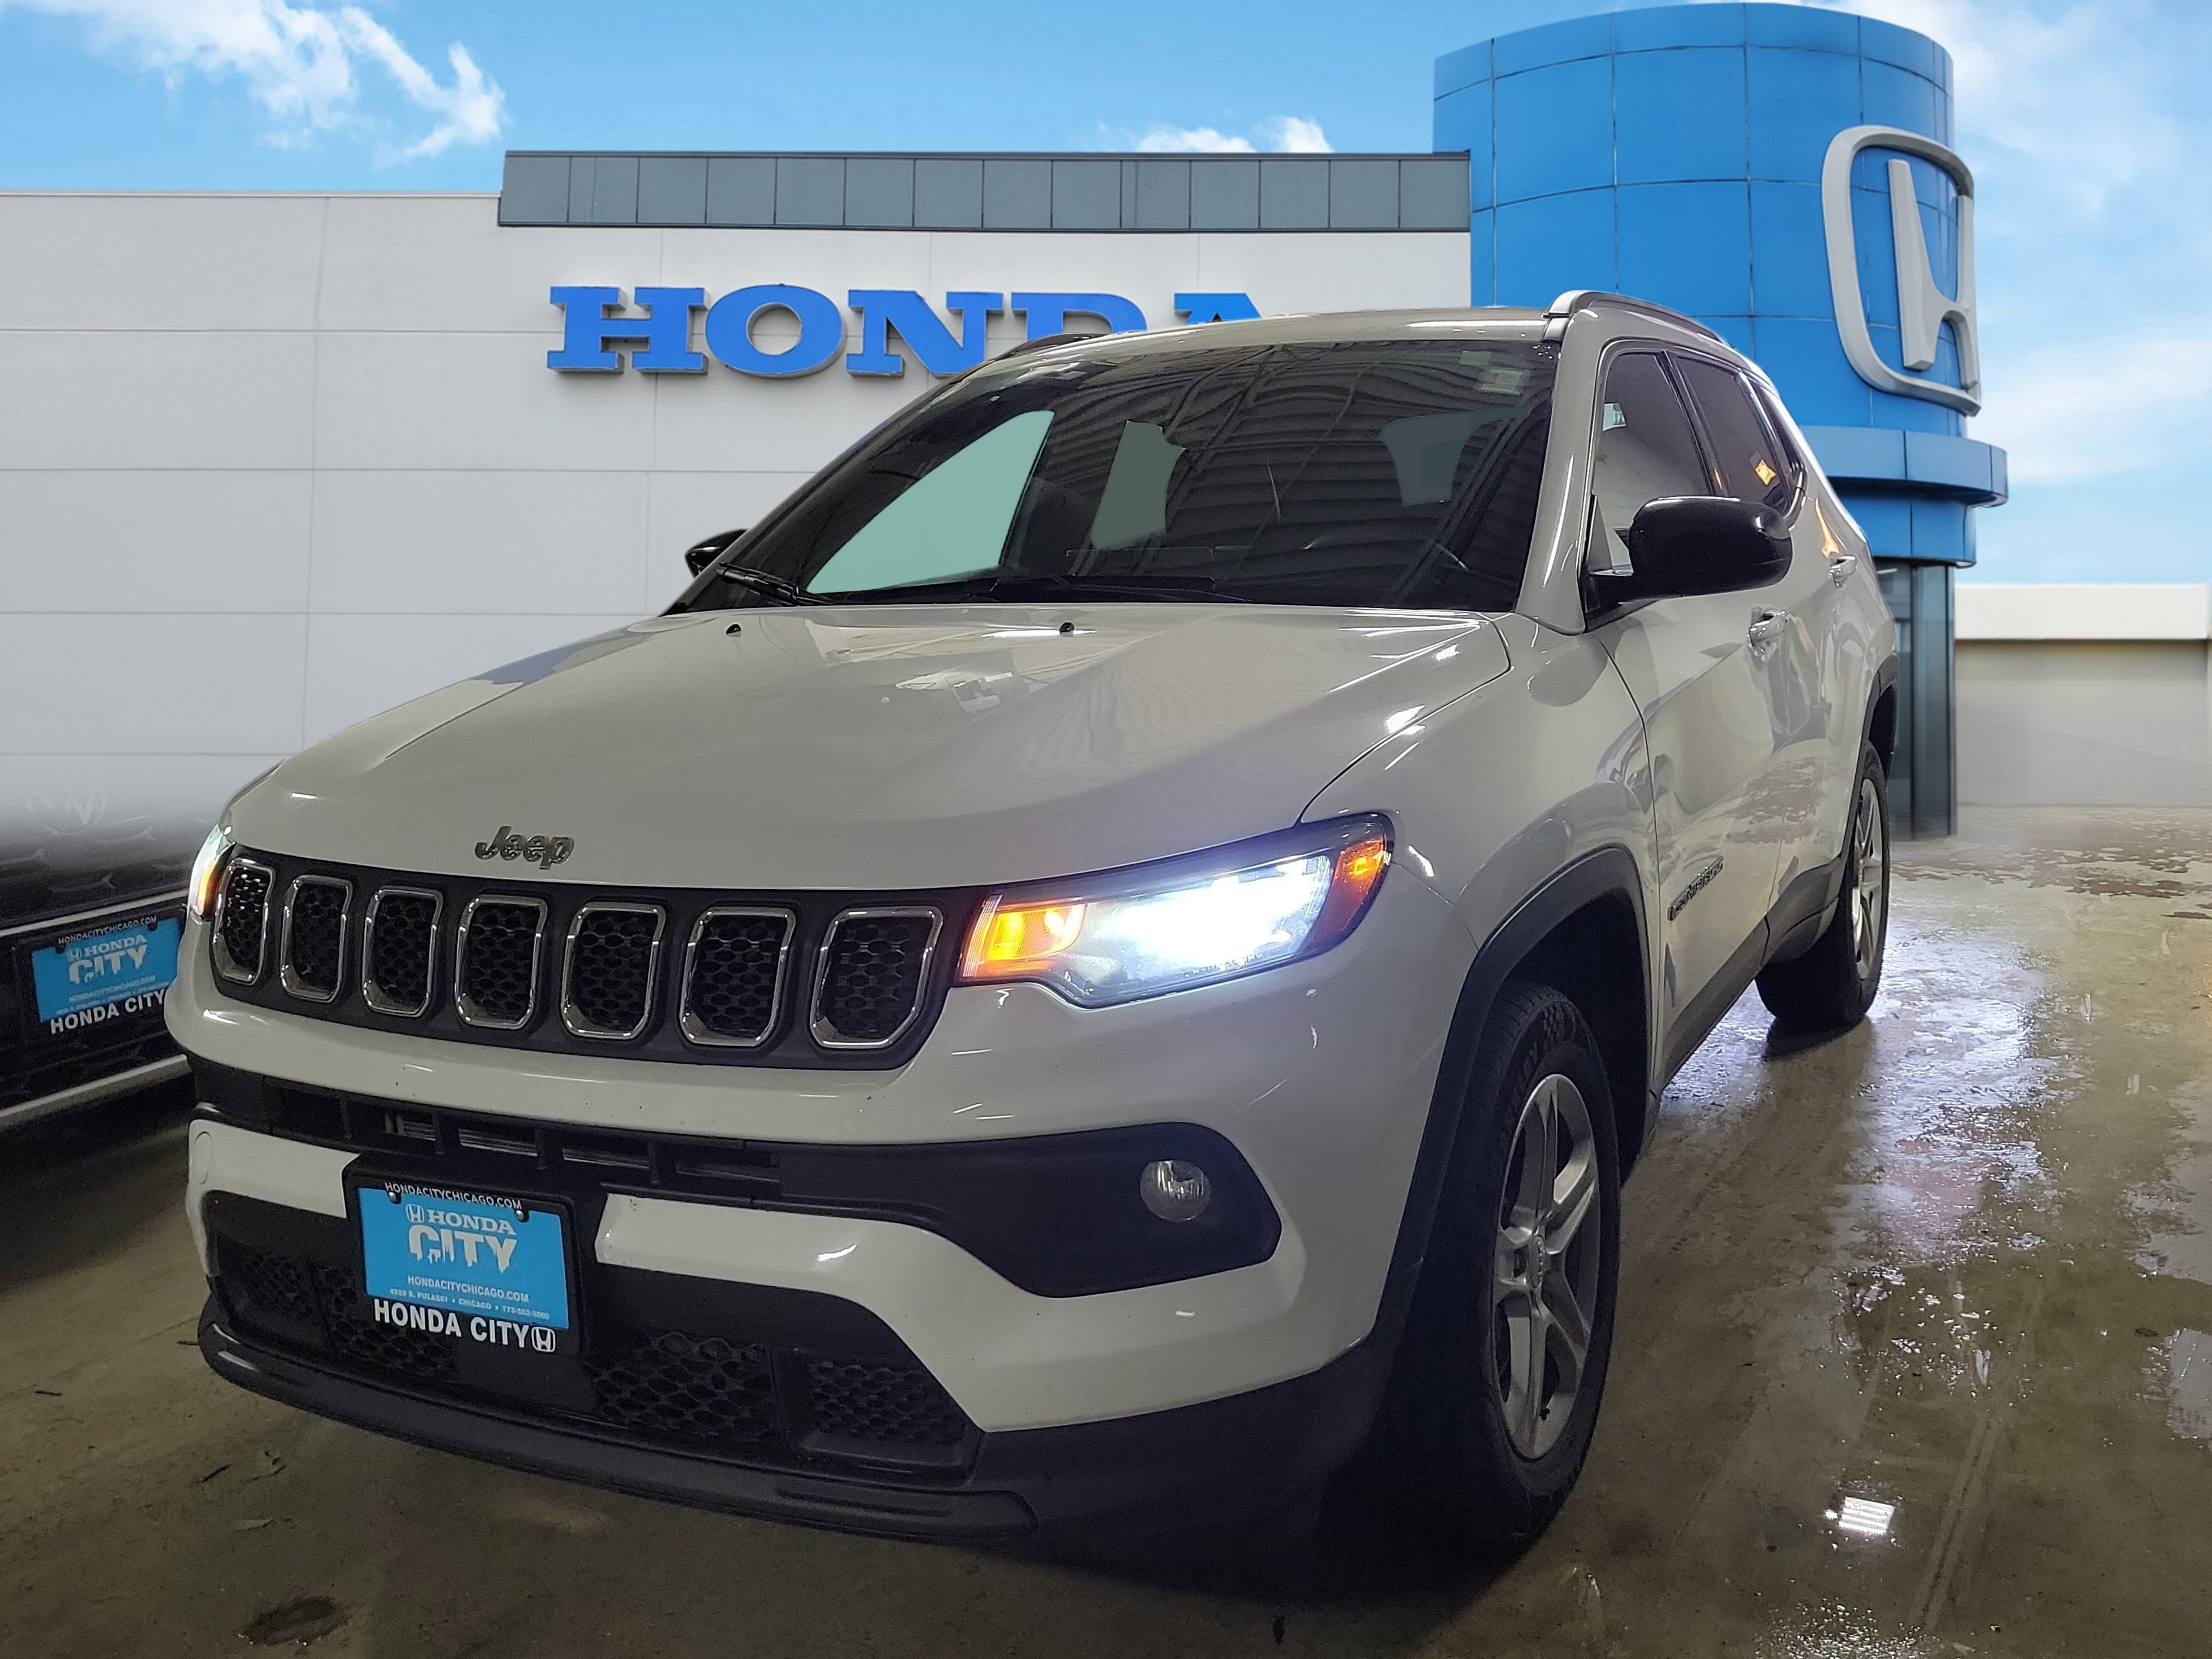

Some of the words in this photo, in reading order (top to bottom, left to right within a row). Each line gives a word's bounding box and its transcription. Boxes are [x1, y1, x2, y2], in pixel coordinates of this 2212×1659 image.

[474, 825, 574, 870] Jeep
[58, 915, 157, 944] HONDACITYCHICAGO.COM
[84, 935, 147, 957] HONDA
[69, 943, 147, 985] CITY
[50, 1002, 120, 1034] HONDA
[125, 989, 165, 1013] CITY
[385, 1182, 522, 1210] HONDACITYCHICAGO.COM
[427, 1209, 517, 1236] HONDA
[409, 1224, 518, 1274] CITY
[407, 1275, 530, 1303] HONDACITYCHICAGO.COM
[417, 1291, 448, 1303] PULASKI
[459, 1298, 491, 1309] CHICAGO
[373, 1299, 462, 1337] HONDA
[470, 1317, 531, 1349] CITY
